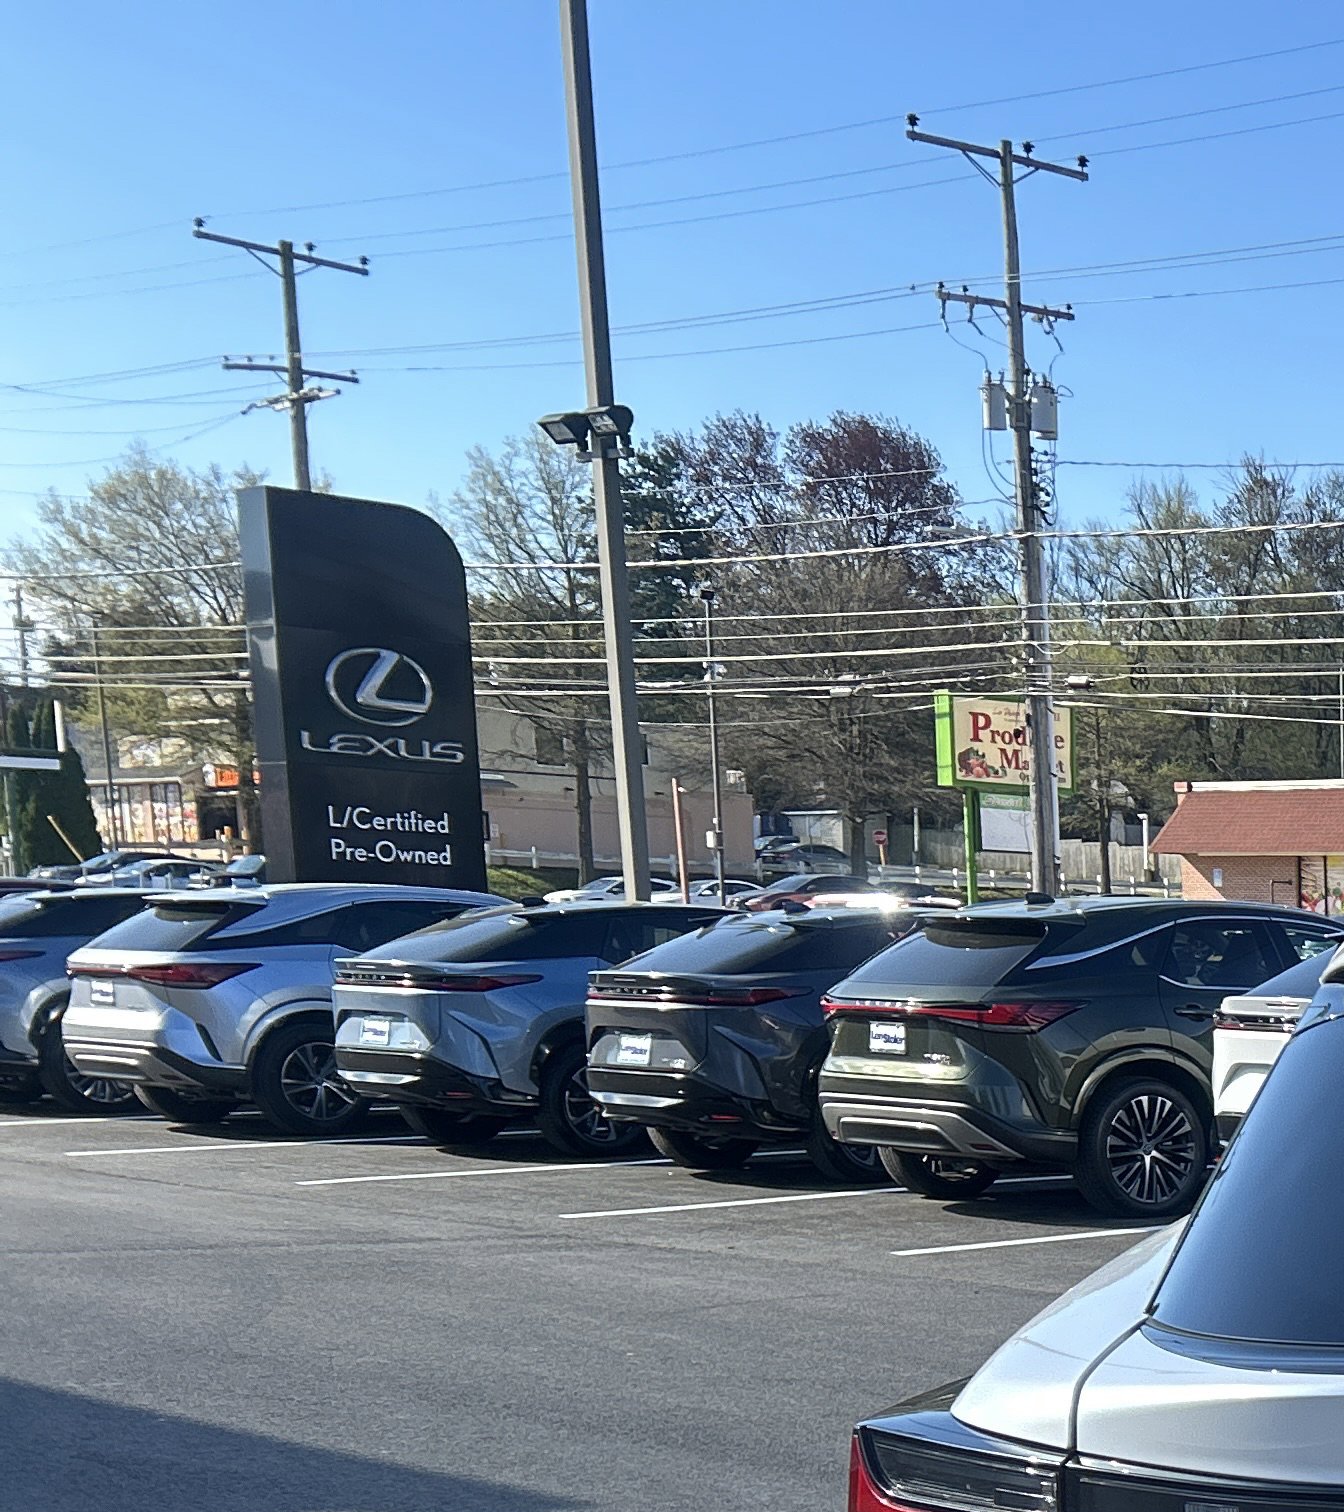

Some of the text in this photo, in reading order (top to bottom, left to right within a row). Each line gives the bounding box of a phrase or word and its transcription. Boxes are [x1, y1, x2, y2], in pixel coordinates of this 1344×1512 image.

[968, 711, 1065, 749] Prode
[301, 730, 465, 764] LEXUS
[997, 747, 1065, 774] Mat
[327, 805, 449, 834] L/Certified
[330, 838, 452, 866] Pre-Owned
